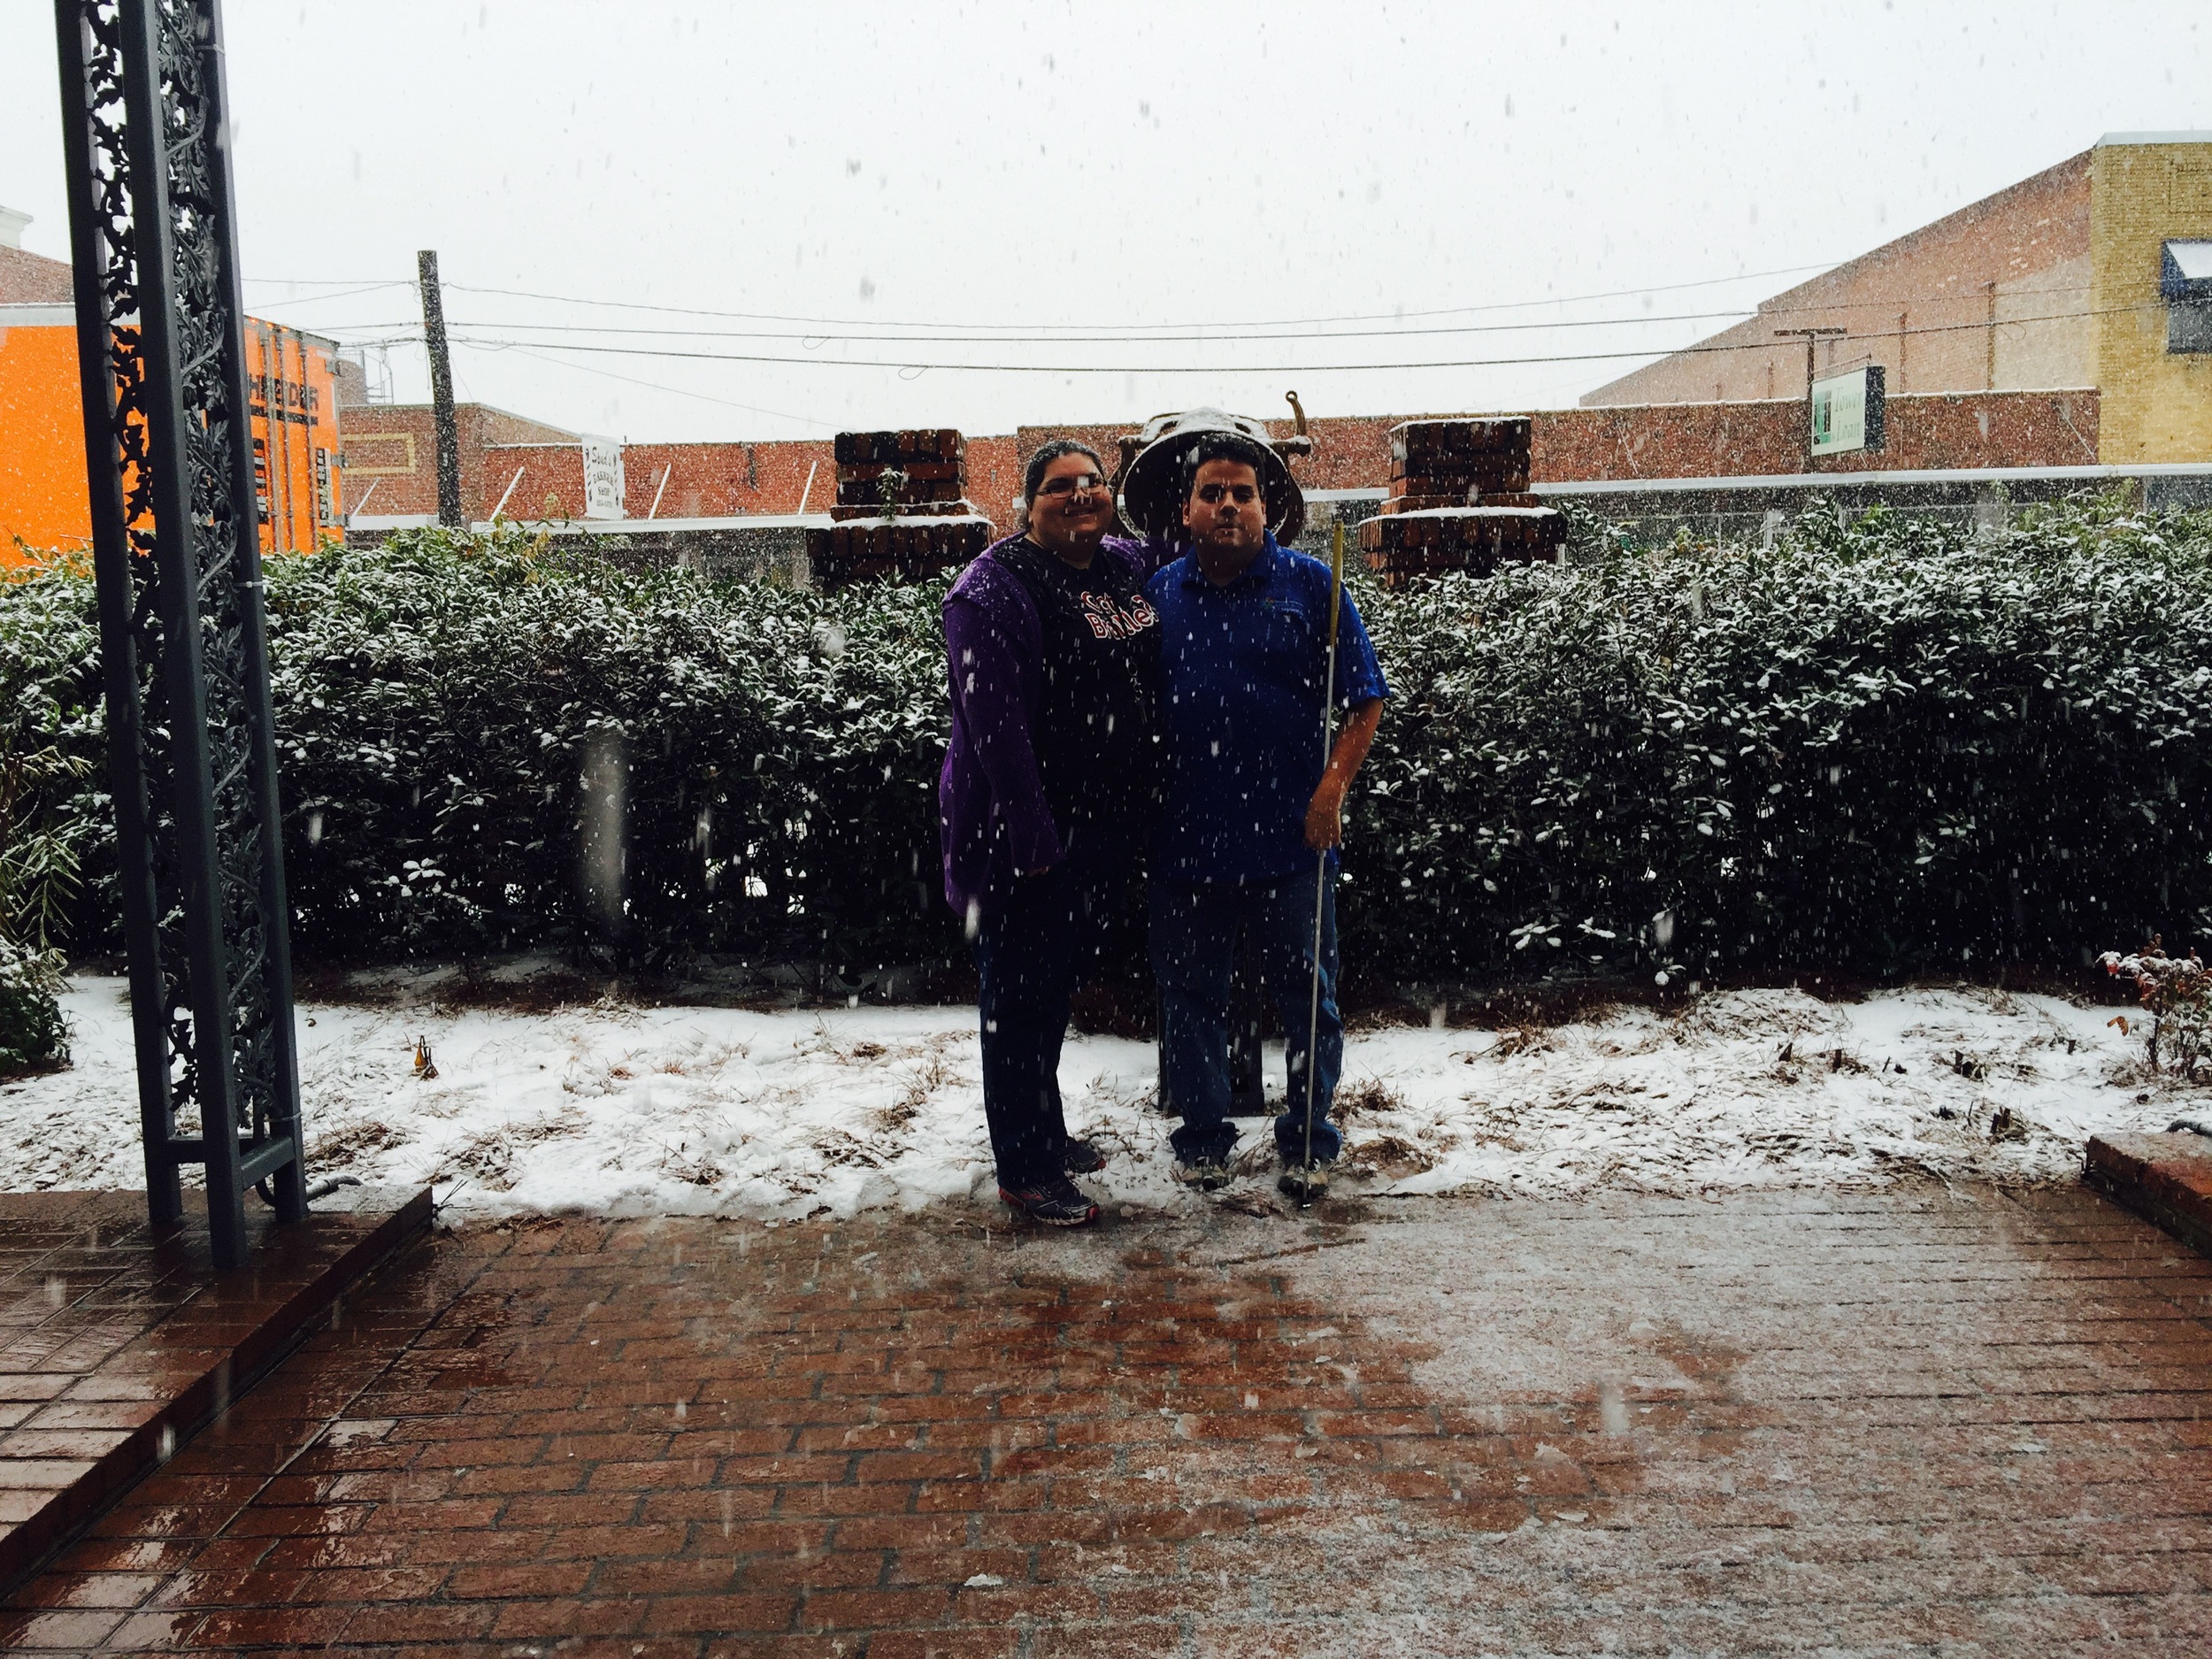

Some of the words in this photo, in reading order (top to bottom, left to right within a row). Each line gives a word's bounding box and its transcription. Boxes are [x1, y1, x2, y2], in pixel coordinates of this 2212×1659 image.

[1834, 386, 1863, 412] Tower
[1836, 415, 1860, 442] Loan
[597, 486, 611, 496] SHOP
